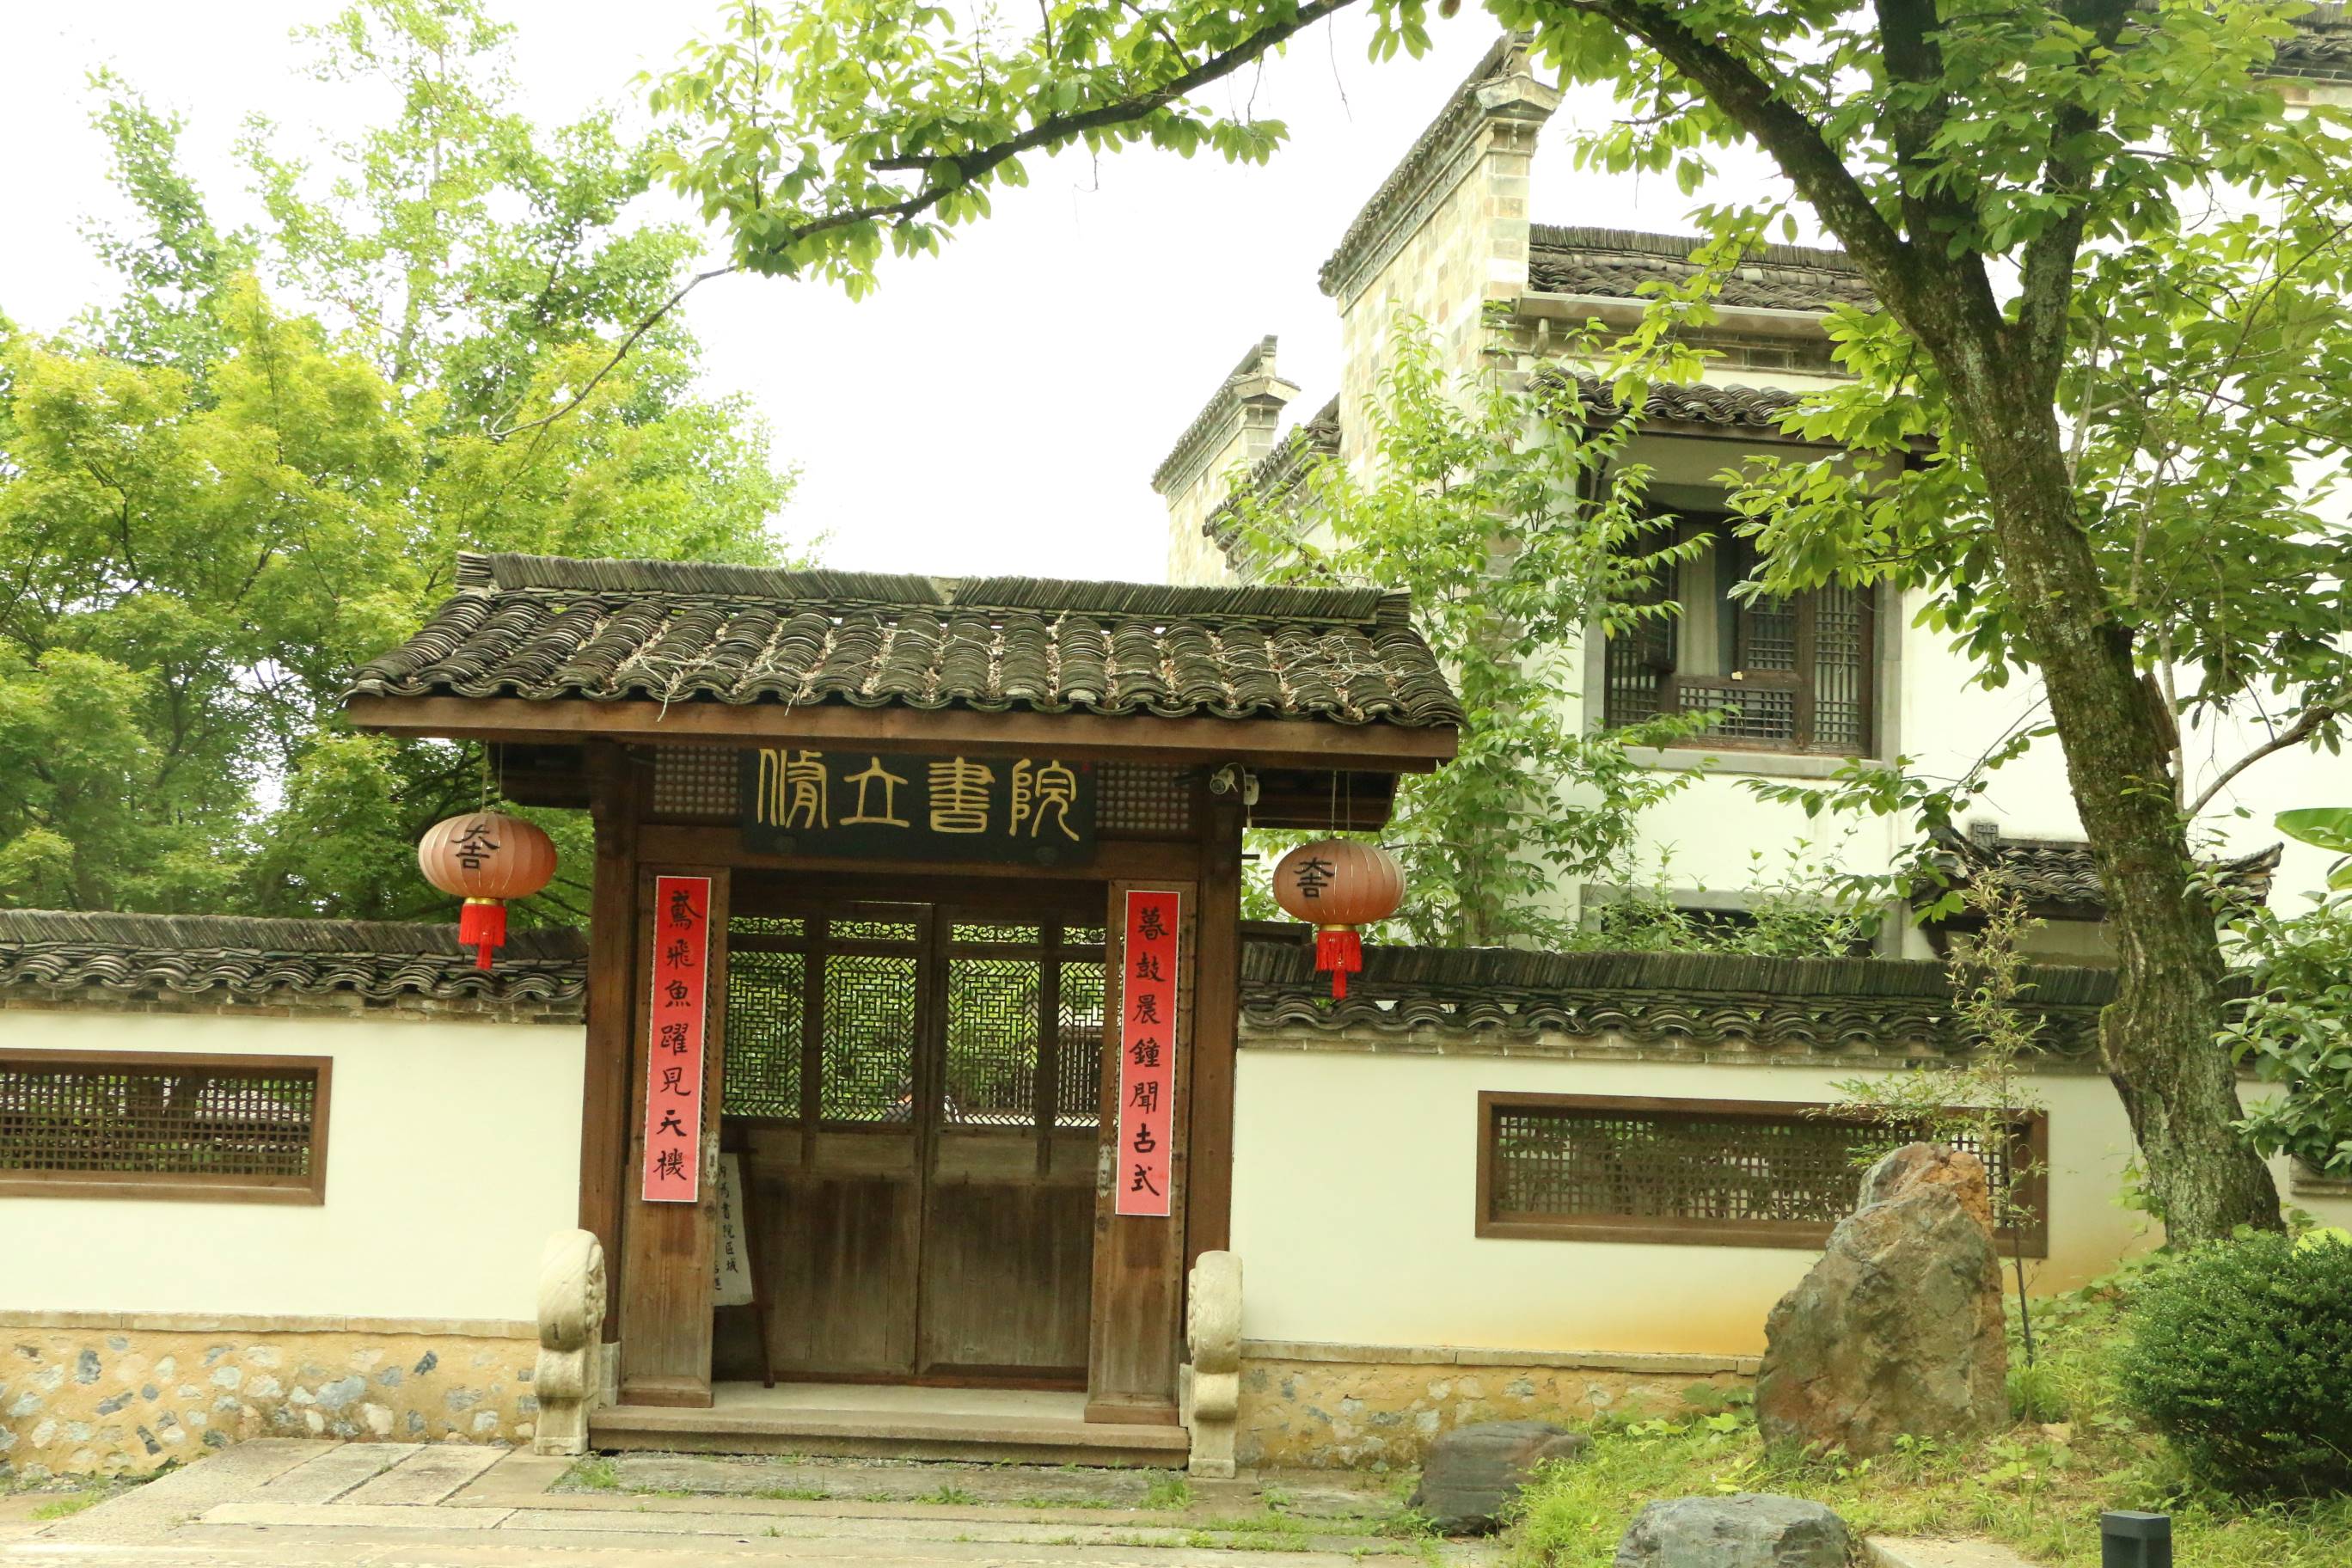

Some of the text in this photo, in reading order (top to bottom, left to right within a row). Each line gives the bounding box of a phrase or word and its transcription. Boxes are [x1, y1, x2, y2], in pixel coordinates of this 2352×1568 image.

[652, 890, 702, 1181] 鳶飛魚躍見天機
[1128, 907, 1170, 1197] 暮鼓晨鐘聞古式
